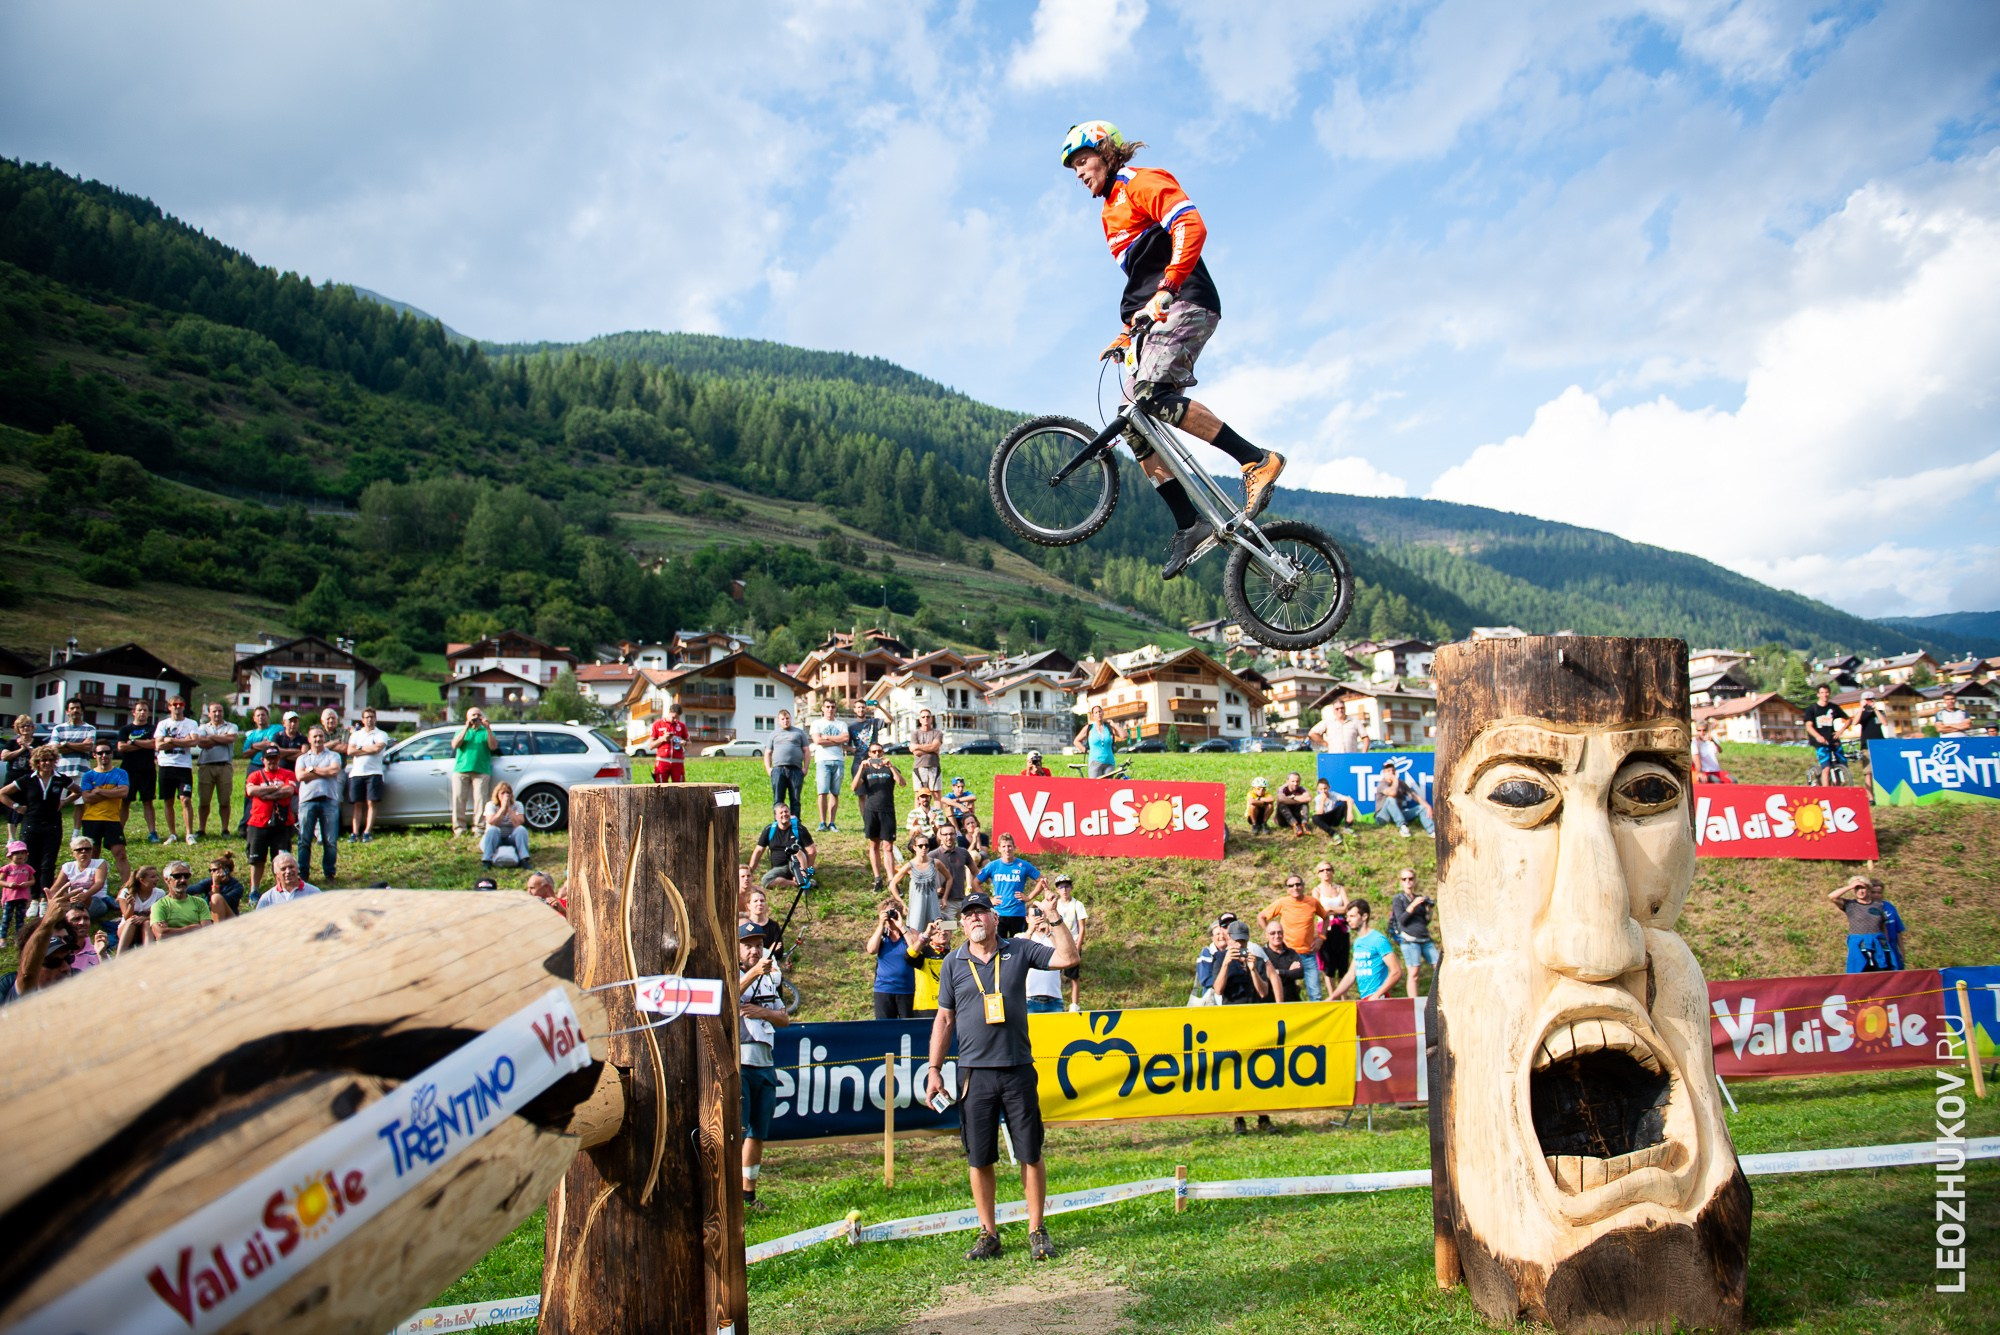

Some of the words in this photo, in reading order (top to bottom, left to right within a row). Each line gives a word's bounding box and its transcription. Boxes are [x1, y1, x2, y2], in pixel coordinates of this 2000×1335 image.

[1008, 790, 1076, 843] Val
[1079, 808, 1110, 837] di
[1109, 788, 1210, 837] Sole
[1743, 812, 1770, 839] di
[1765, 793, 1860, 839] Sole
[994, 873, 1021, 882] ITALIA
[1056, 1019, 1326, 1100] Melinda
[1711, 997, 1788, 1061] Val
[1791, 1018, 1824, 1054] di
[1820, 994, 1929, 1053] Sole
[378, 1055, 517, 1178] TRENTINO
[146, 1244, 241, 1329] Val
[239, 1231, 275, 1281] di
